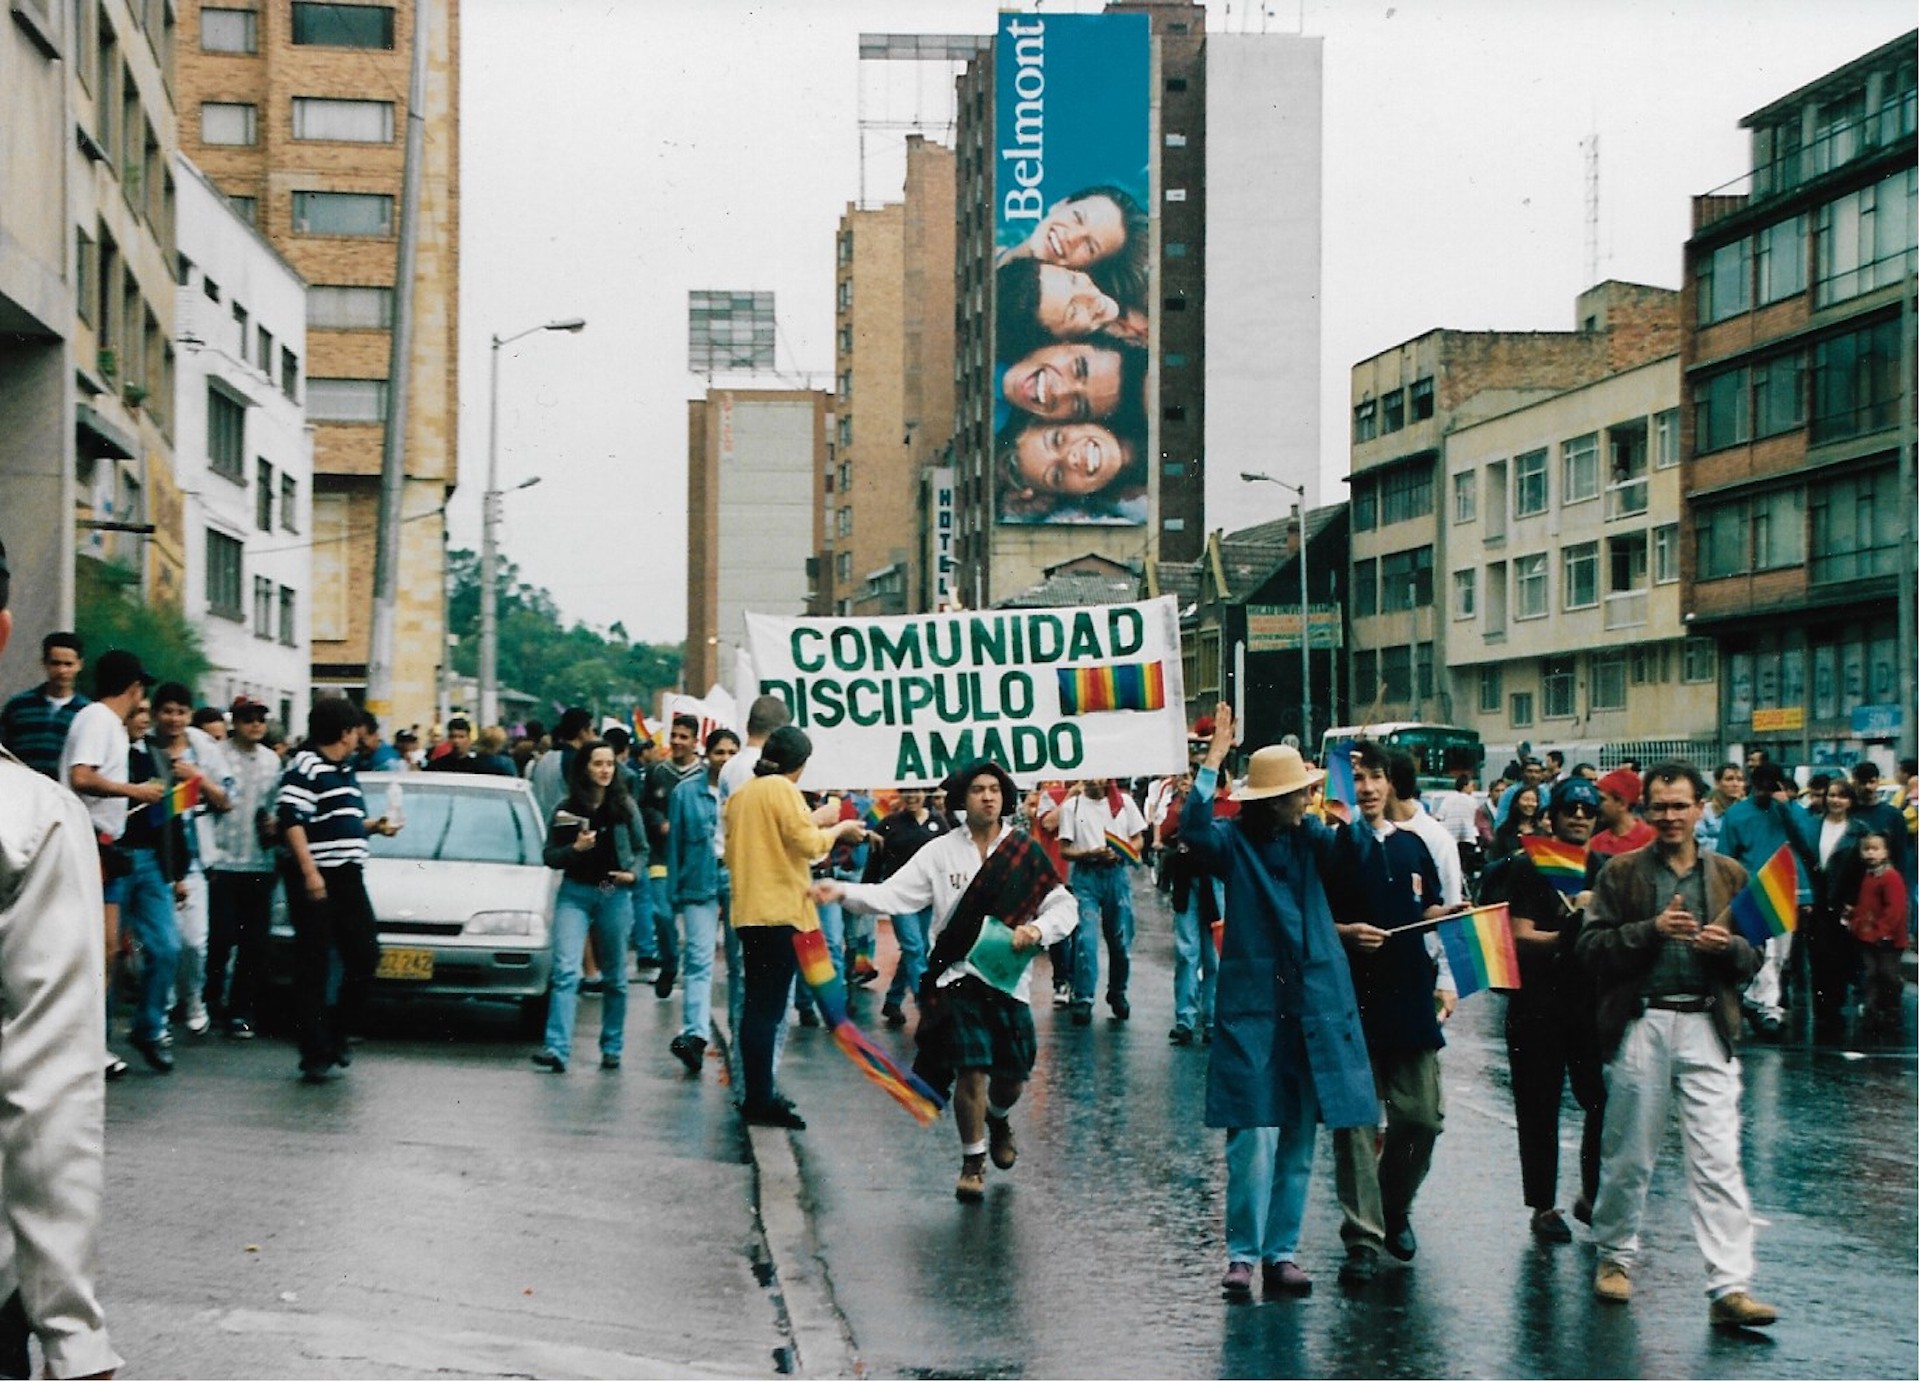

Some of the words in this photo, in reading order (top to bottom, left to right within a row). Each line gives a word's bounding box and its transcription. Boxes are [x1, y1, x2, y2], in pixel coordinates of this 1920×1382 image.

[1002, 18, 1045, 222] Belmont
[939, 488, 951, 595] HOTEL
[791, 607, 1144, 674] COMUNIDAD
[760, 669, 1035, 729] DISCIPULO
[895, 722, 1084, 781] AMADO
